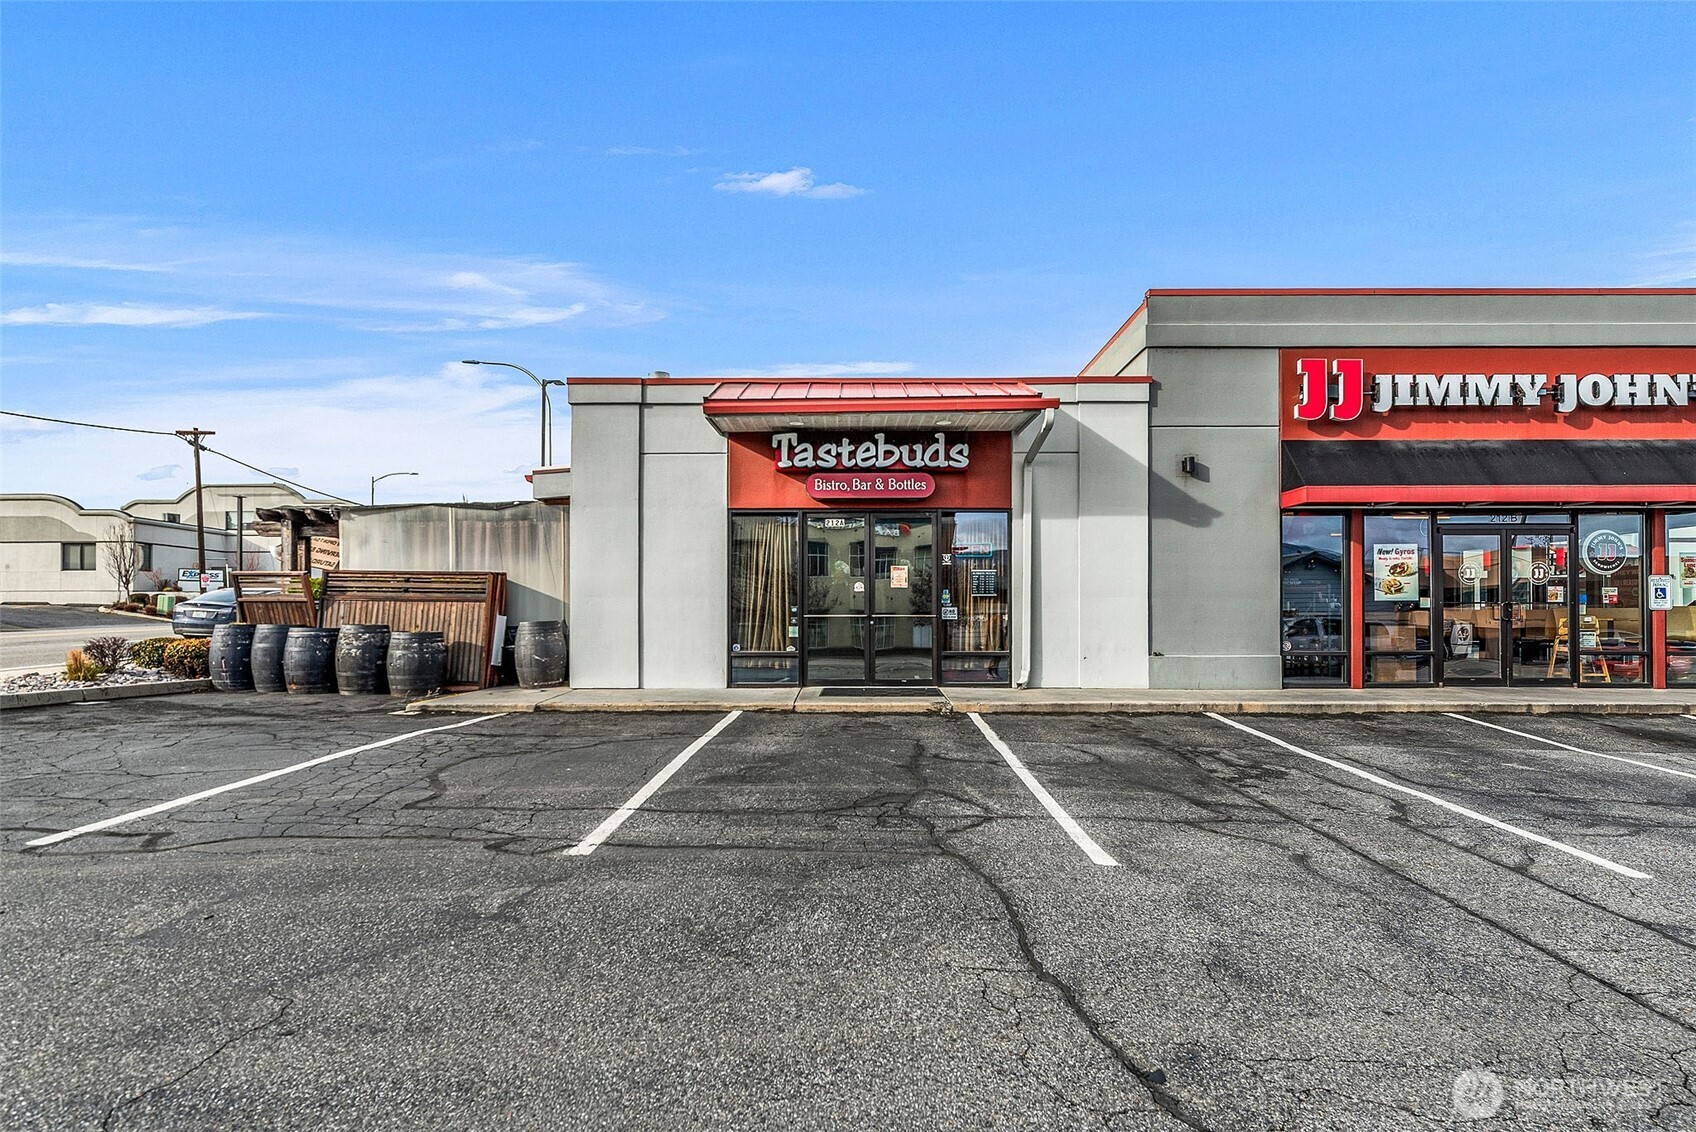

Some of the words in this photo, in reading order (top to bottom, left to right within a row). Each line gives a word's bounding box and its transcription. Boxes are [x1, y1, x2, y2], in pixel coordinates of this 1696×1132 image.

[1294, 358, 1363, 421] JJ
[1371, 373, 1547, 413] JIMMY
[771, 432, 970, 469] Tastebuds
[814, 478, 850, 492] Bistro,
[852, 479, 871, 491] Bar
[875, 479, 884, 491] &
[888, 478, 927, 491] Bottles
[1395, 548, 1415, 556] Gyros
